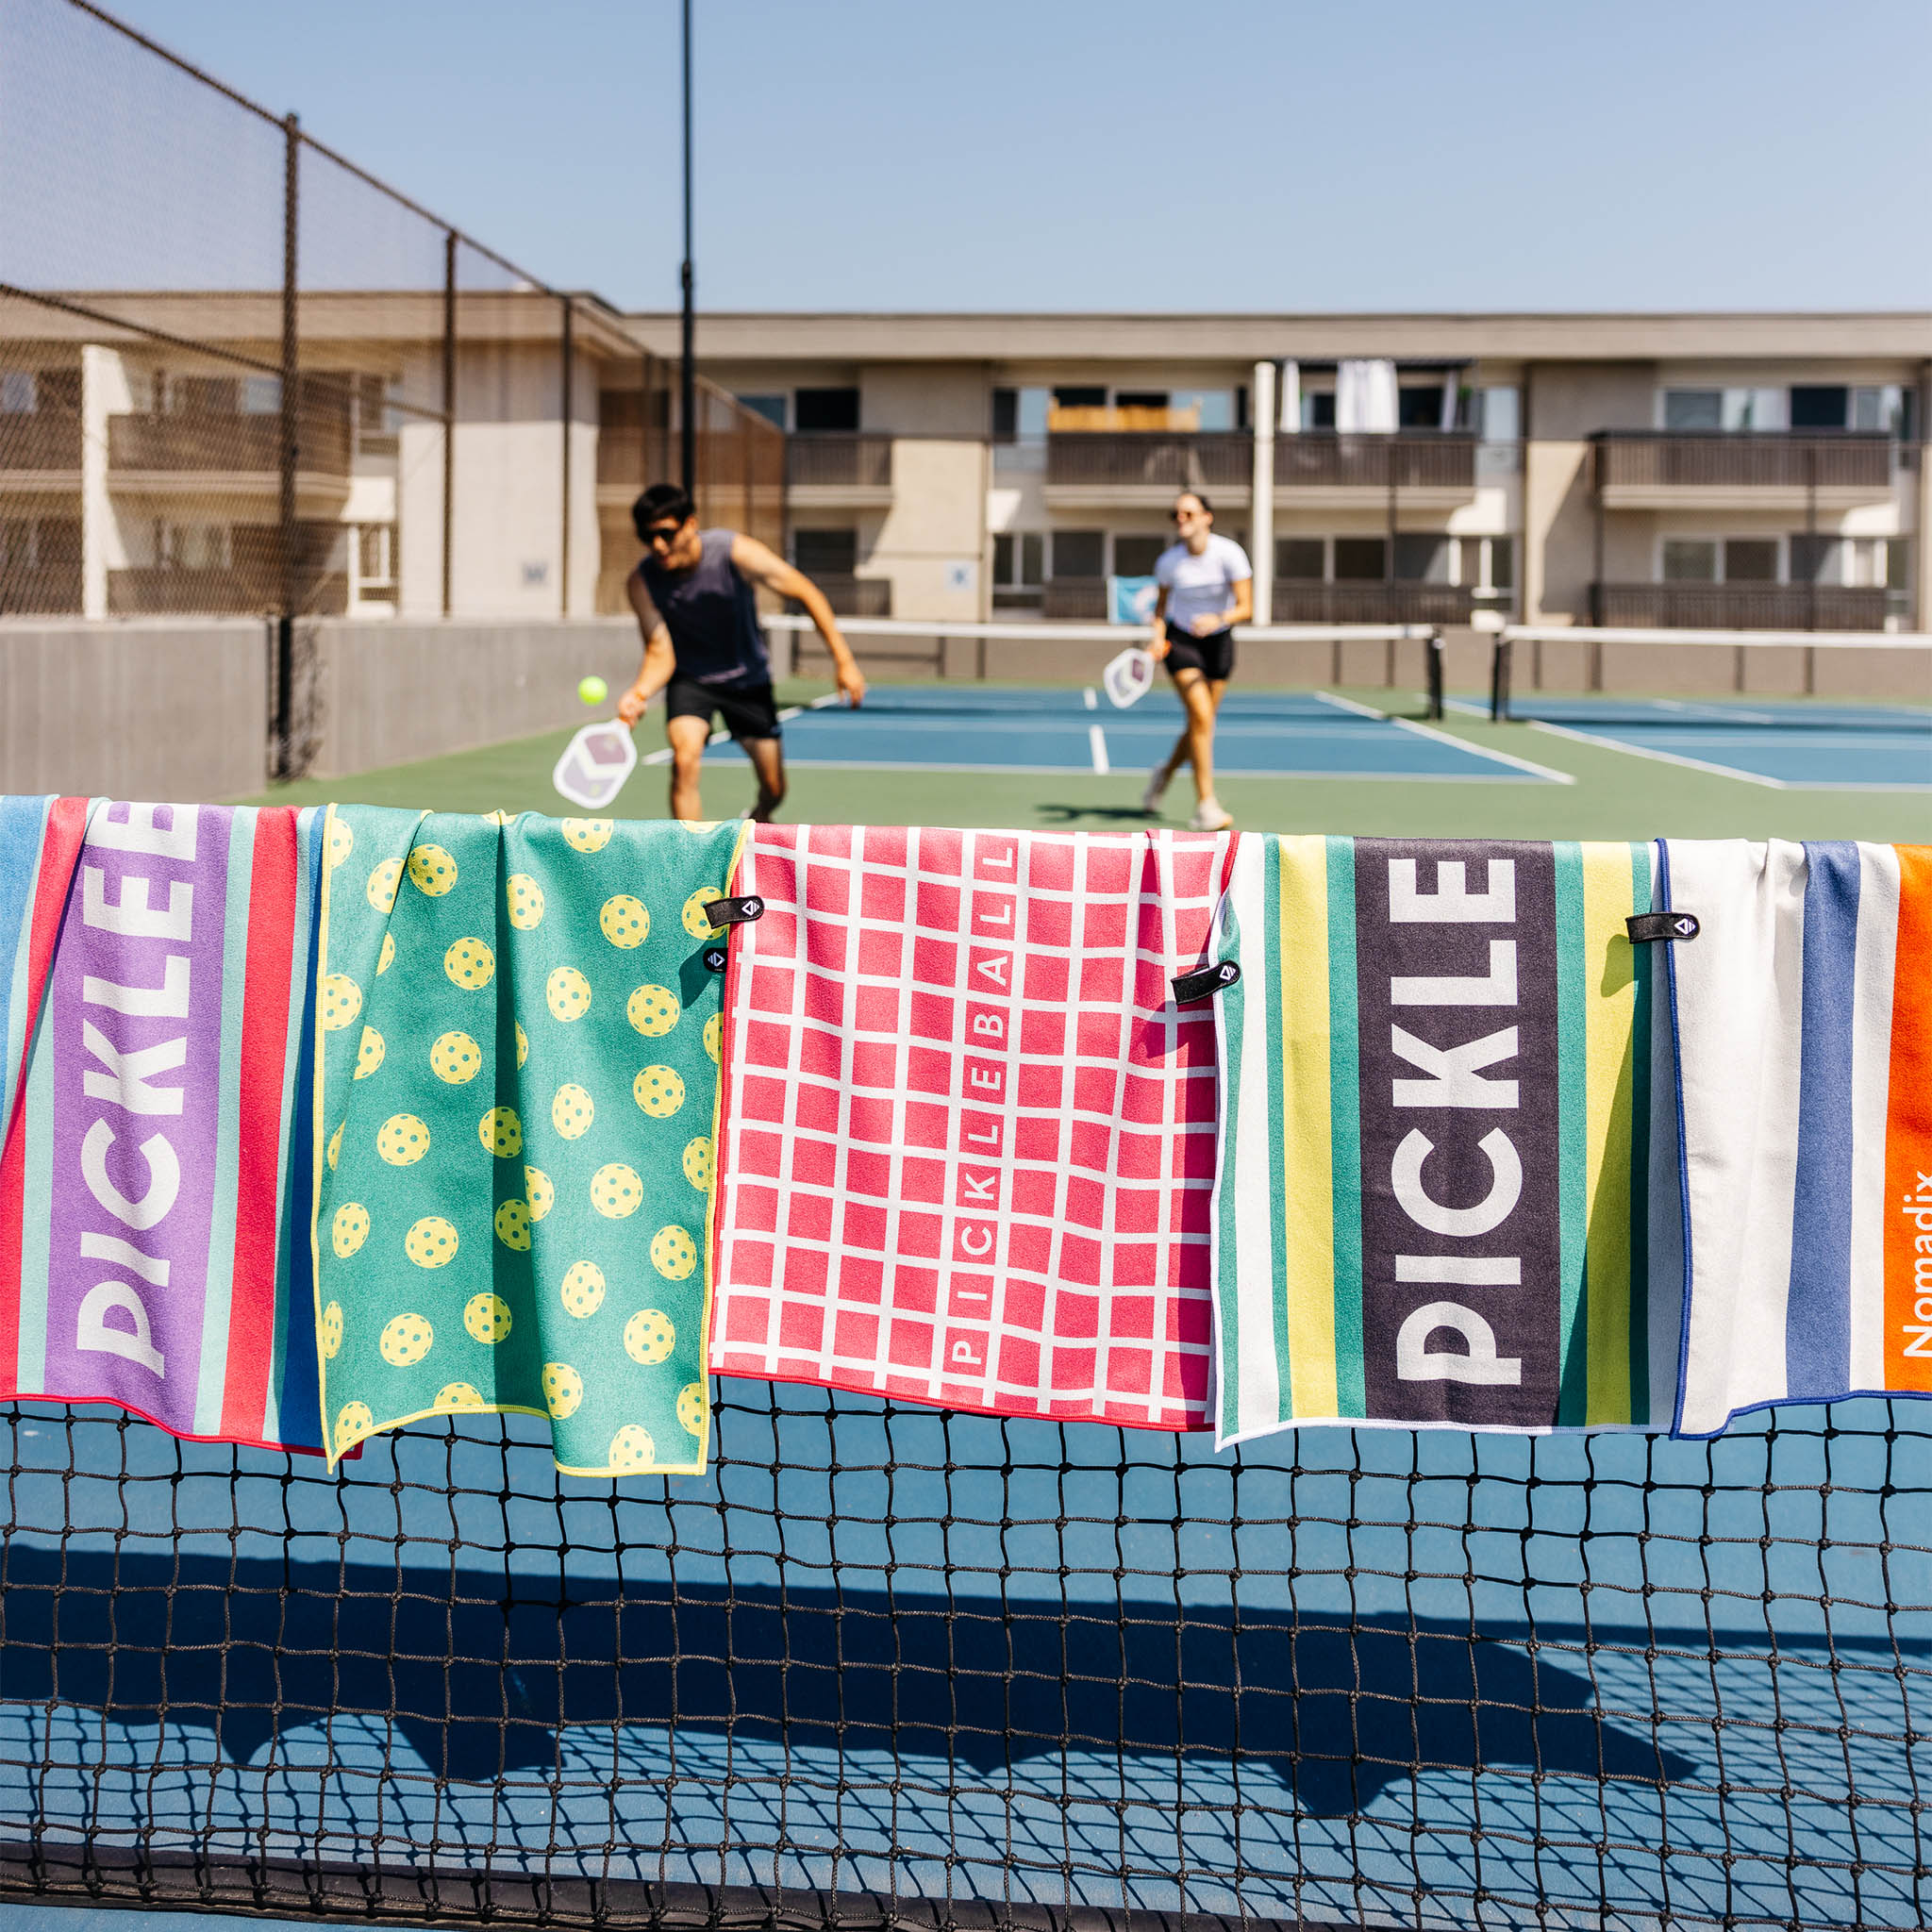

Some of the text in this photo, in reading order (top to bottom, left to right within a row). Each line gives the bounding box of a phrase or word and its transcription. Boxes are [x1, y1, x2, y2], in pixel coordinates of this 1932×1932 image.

[952, 847, 1013, 1364] PICKLEBALL
[1389, 858, 1523, 1385] PICKLE
[1903, 1170, 1932, 1357] Nomadix
